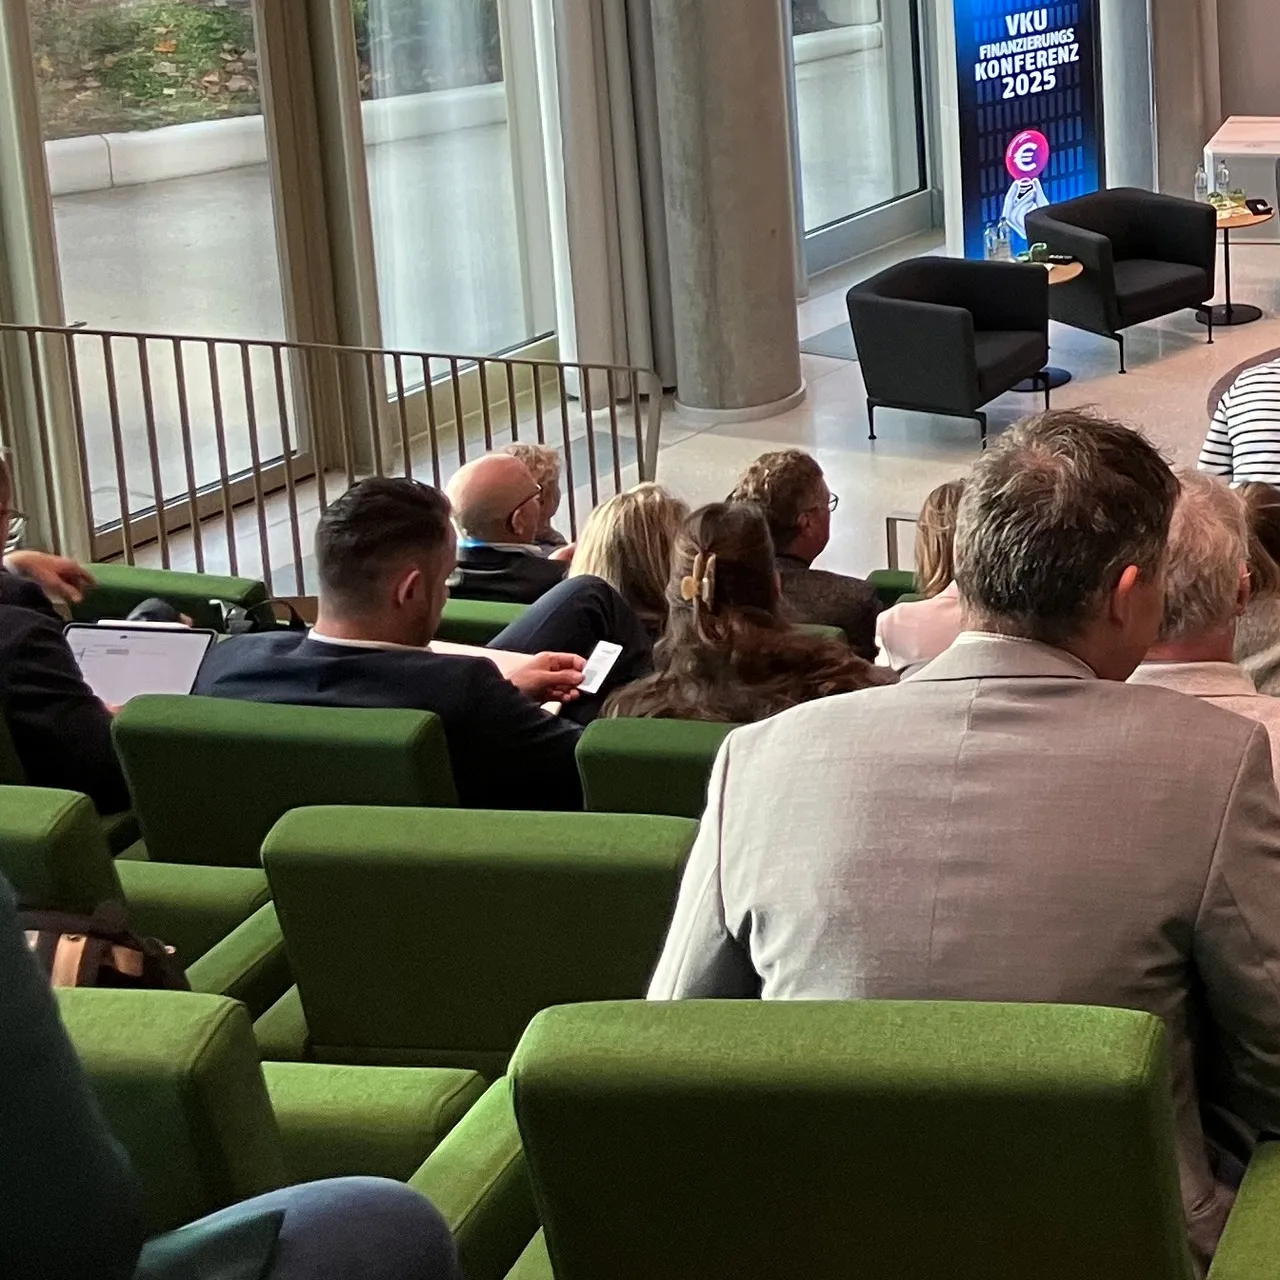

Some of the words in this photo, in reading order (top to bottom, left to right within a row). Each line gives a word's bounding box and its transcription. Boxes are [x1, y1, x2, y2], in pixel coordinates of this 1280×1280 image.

[1005, 8, 1048, 37] VKU
[979, 27, 1075, 61] FINANZIERUNGS
[974, 42, 1080, 82] KONFERENZ
[1002, 68, 1057, 100] 2025
